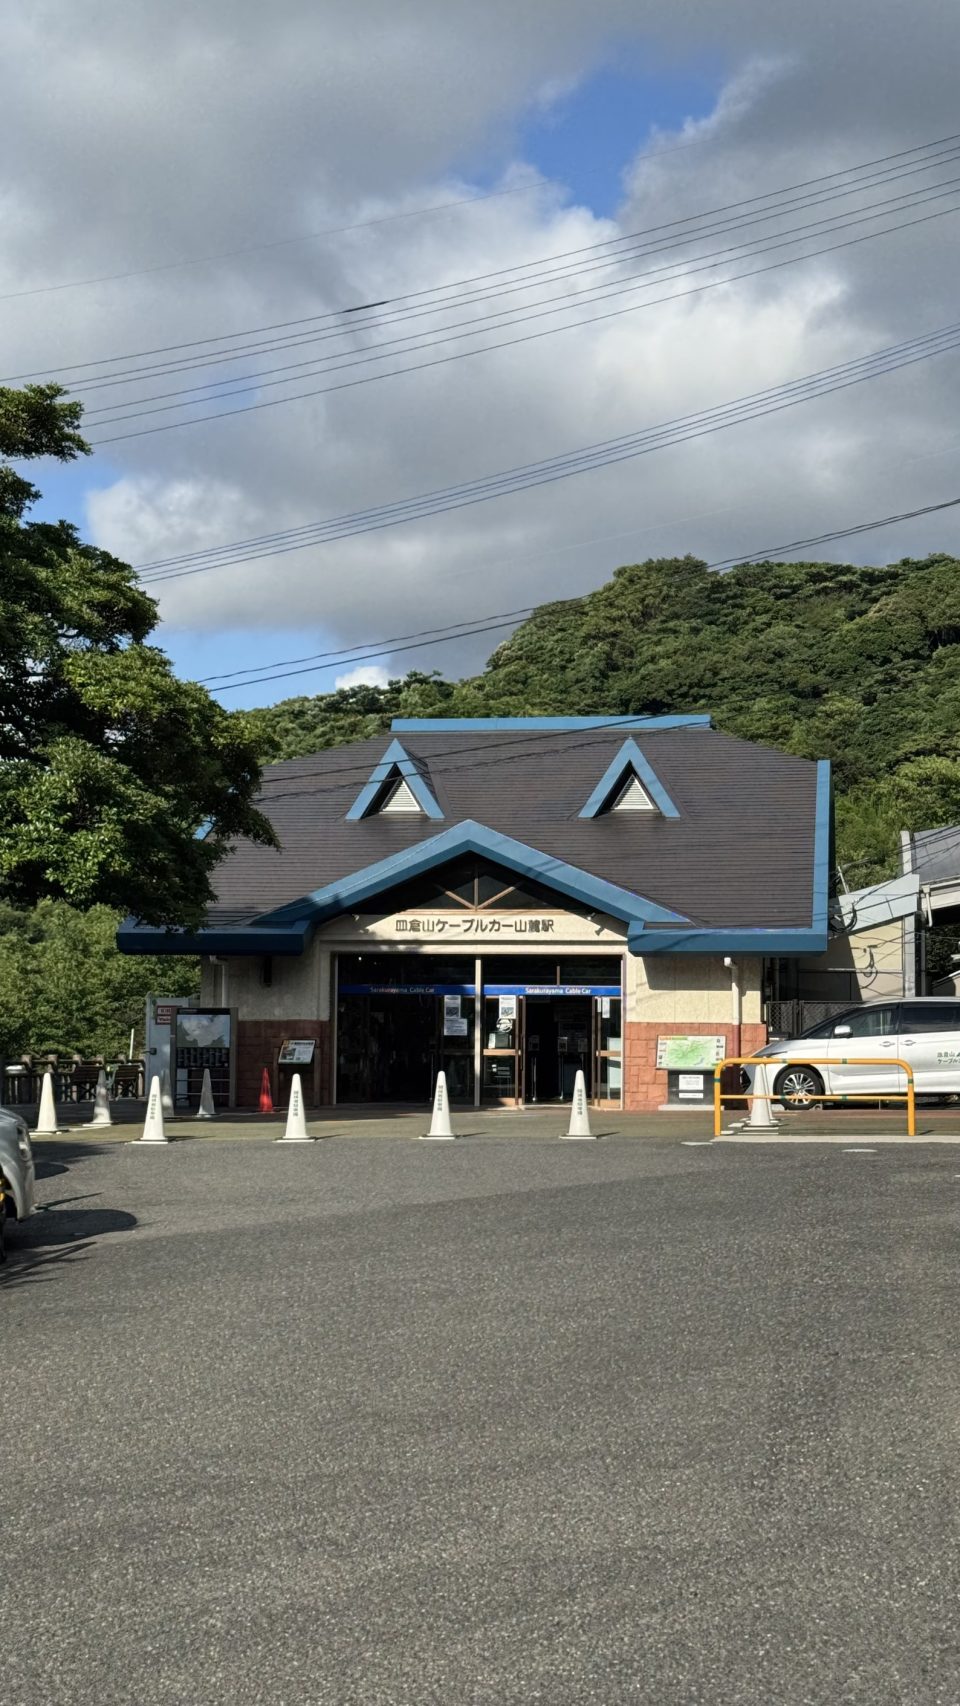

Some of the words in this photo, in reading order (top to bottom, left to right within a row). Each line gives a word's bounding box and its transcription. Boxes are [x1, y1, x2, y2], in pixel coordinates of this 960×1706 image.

[395, 919, 554, 933] 皿倉山ケーブルカー山麓駅
